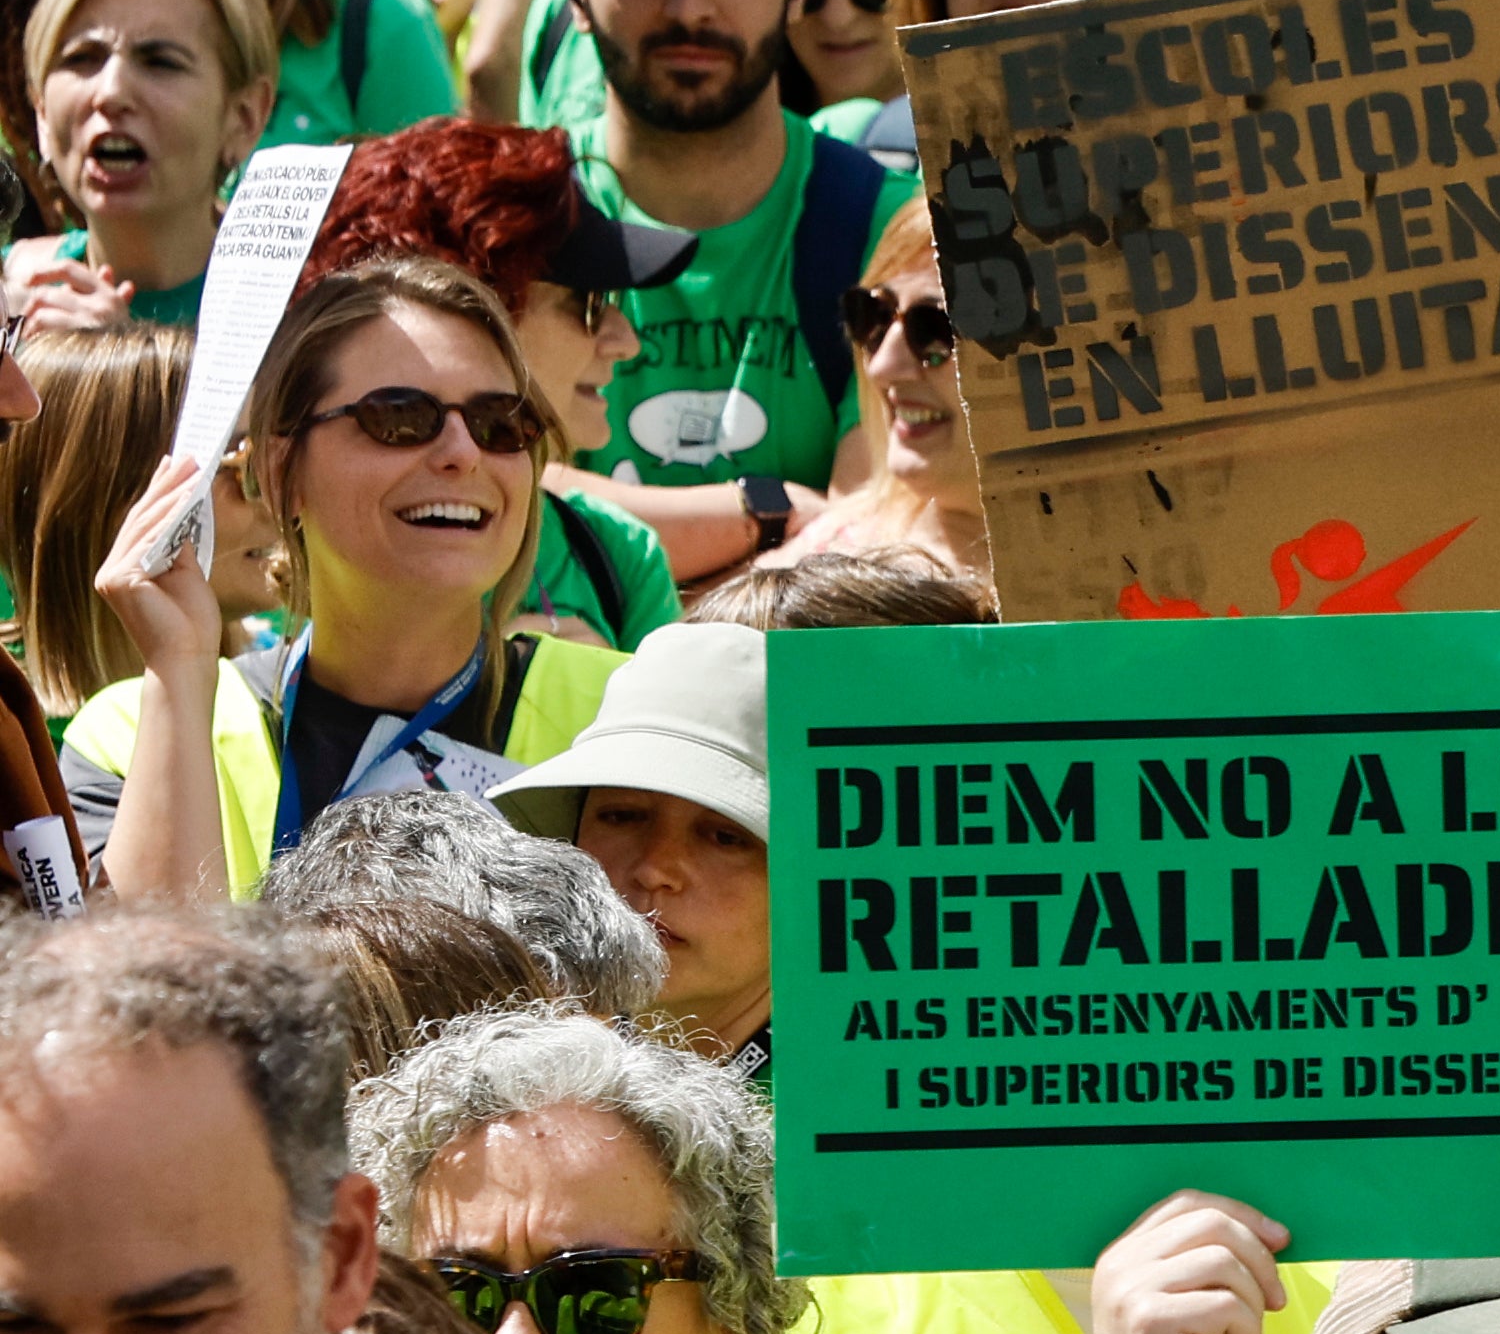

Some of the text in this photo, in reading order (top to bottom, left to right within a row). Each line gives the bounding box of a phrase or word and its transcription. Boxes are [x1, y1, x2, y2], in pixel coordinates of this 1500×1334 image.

[1016, 335, 1163, 432] EN
[815, 760, 1096, 850] DIEM
[1138, 755, 1292, 841] NO
[1327, 753, 1407, 837] A
[842, 996, 948, 1042] ALS
[965, 983, 1419, 1040] ENSENYAMENTS
[884, 1068, 901, 1110] I
[918, 1059, 1235, 1109] SUPERIORS
[1253, 1055, 1324, 1102] DE
